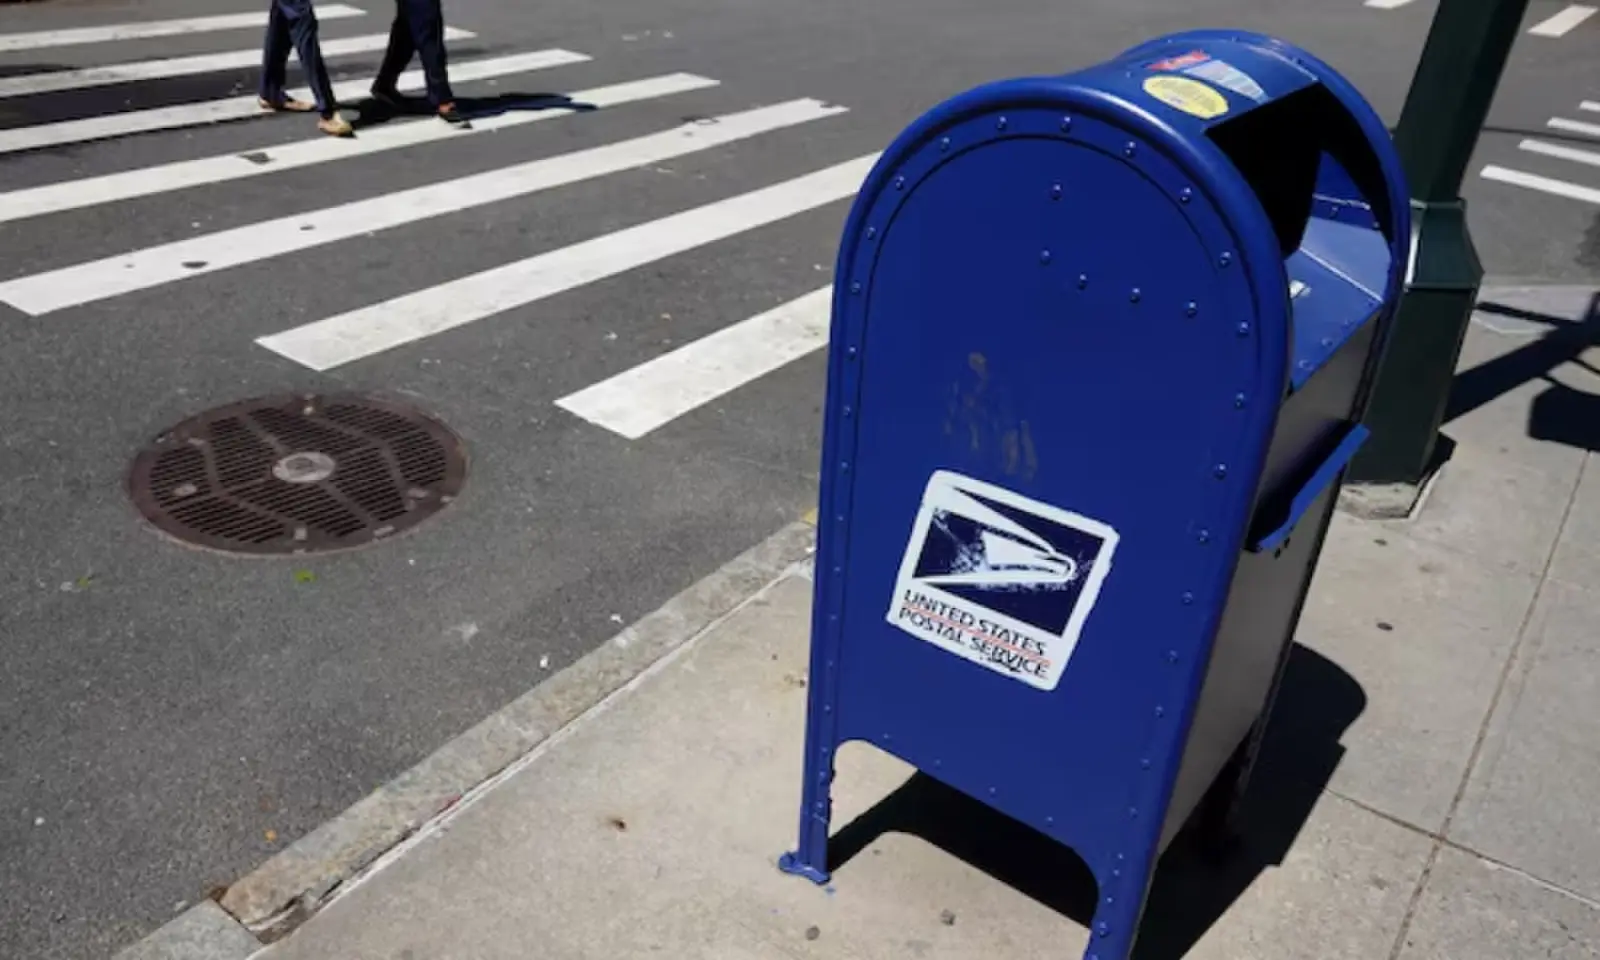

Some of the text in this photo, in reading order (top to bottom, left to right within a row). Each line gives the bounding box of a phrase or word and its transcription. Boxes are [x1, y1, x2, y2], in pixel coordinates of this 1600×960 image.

[899, 607, 1048, 678] POSTAL SERVICE
[903, 589, 1046, 656] UNITED STATES
